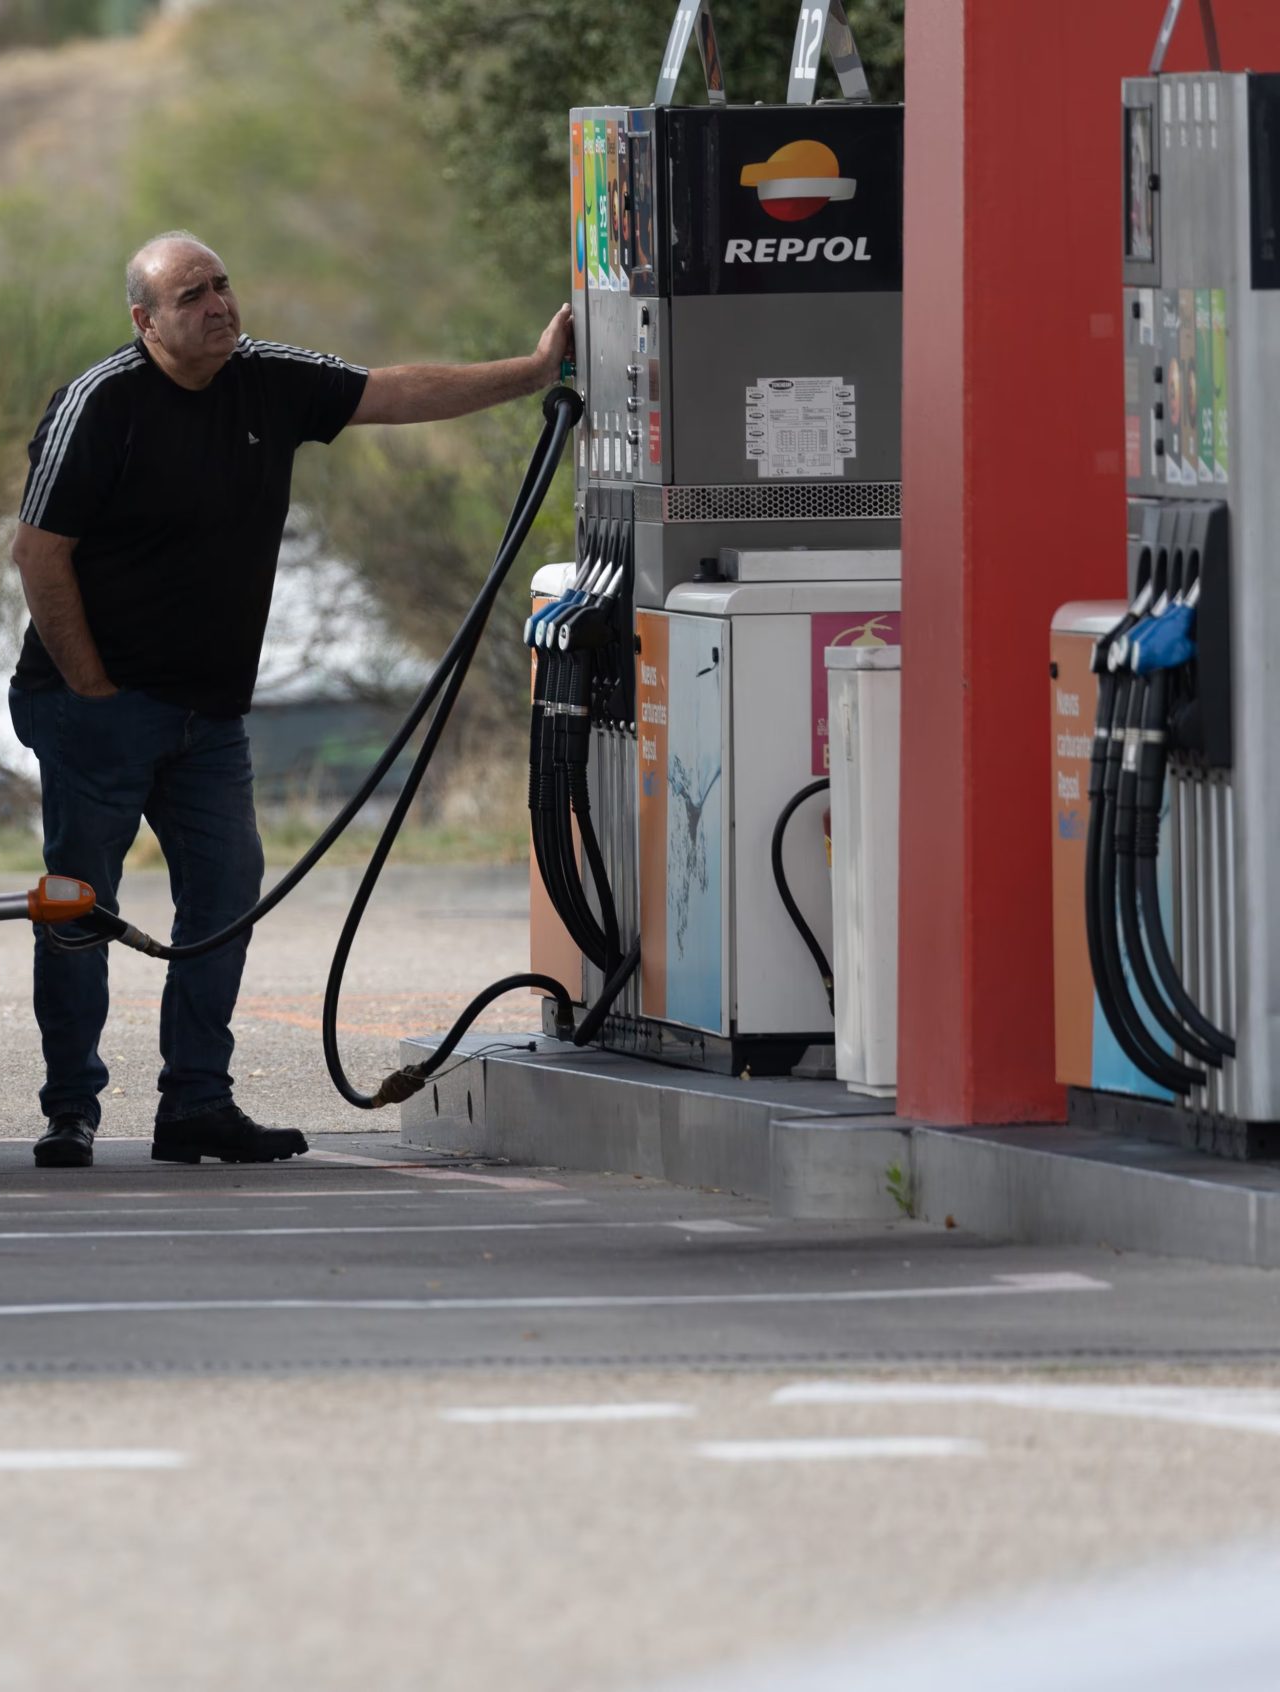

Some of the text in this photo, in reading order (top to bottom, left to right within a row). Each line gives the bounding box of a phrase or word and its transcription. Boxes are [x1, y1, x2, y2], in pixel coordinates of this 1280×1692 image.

[663, 10, 692, 79] 11
[794, 8, 823, 79] 12
[599, 195, 608, 228] 95
[724, 236, 872, 264] REPSOL
